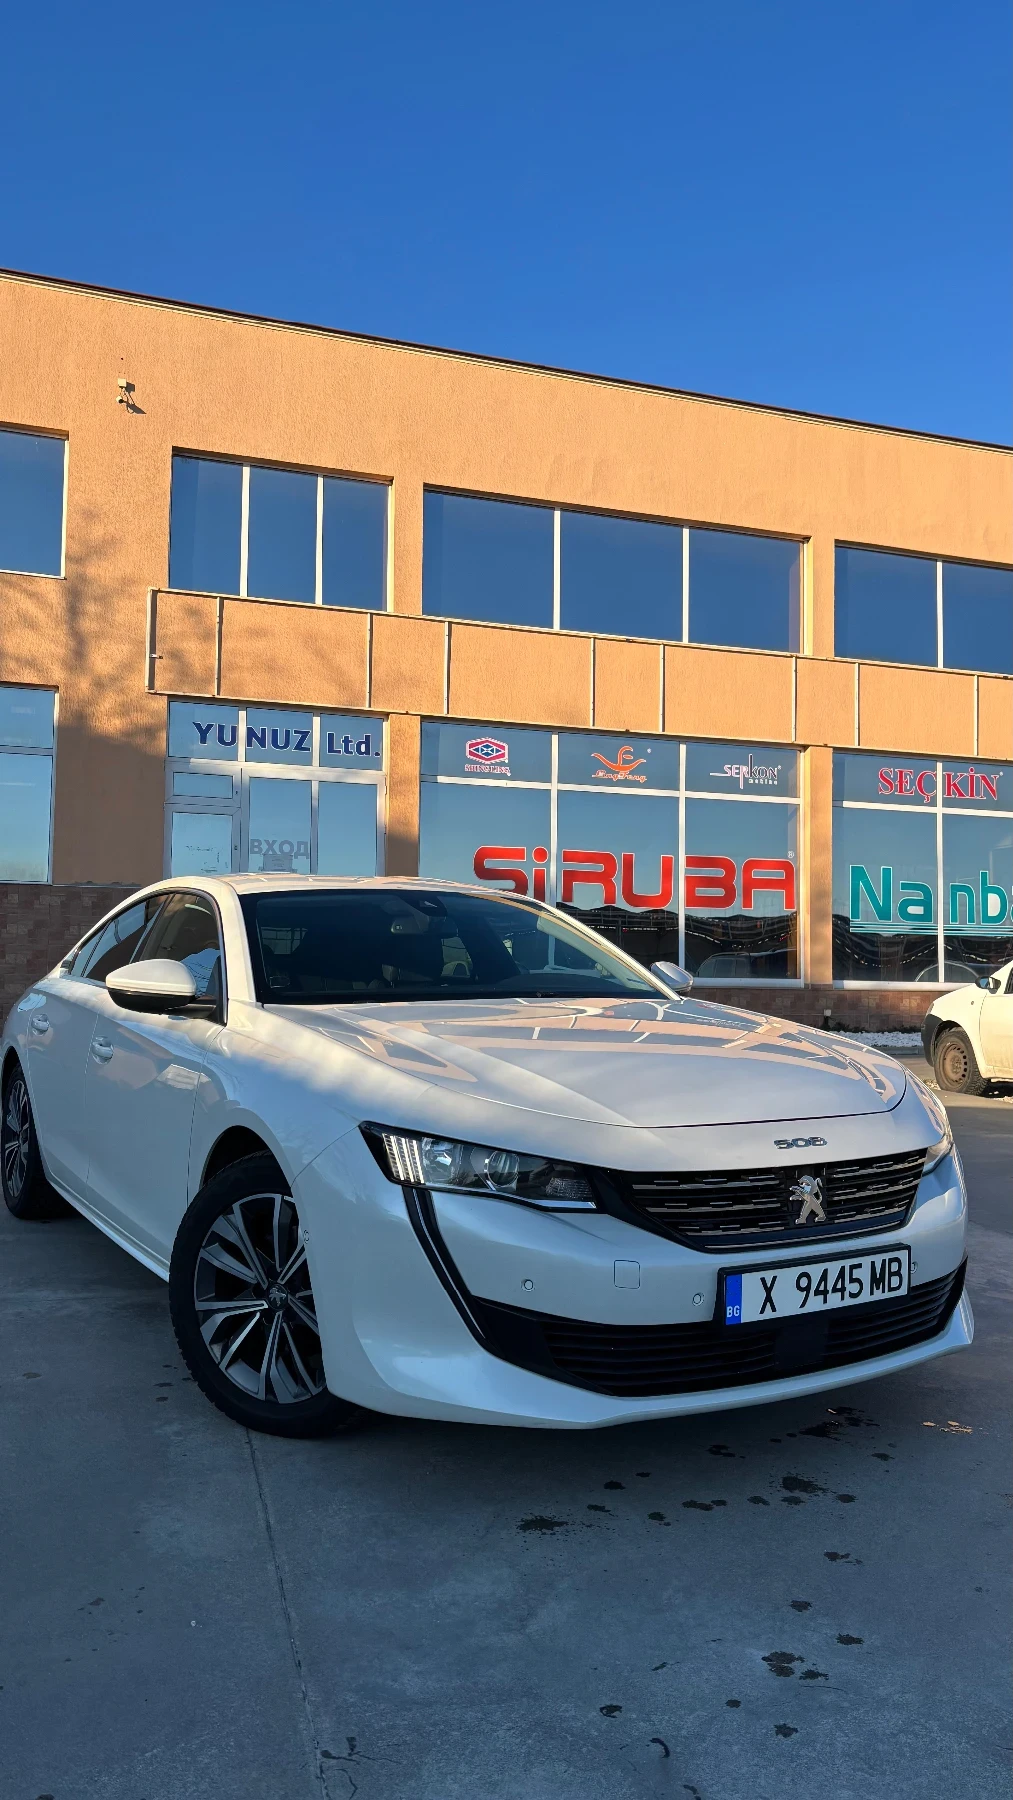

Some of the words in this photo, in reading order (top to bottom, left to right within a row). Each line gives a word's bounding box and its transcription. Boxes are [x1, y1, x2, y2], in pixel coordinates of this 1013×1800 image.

[193, 721, 312, 751] YUNUZ
[327, 732, 381, 757] Ltd.
[878, 767, 999, 803] SEÇKİN
[250, 839, 310, 859] ВХОД
[851, 864, 1013, 924] Nanb
[774, 1136, 828, 1149] 508
[795, 1263, 864, 1309] 9445
[869, 1256, 903, 1296] MB
[726, 1305, 740, 1318] BG
